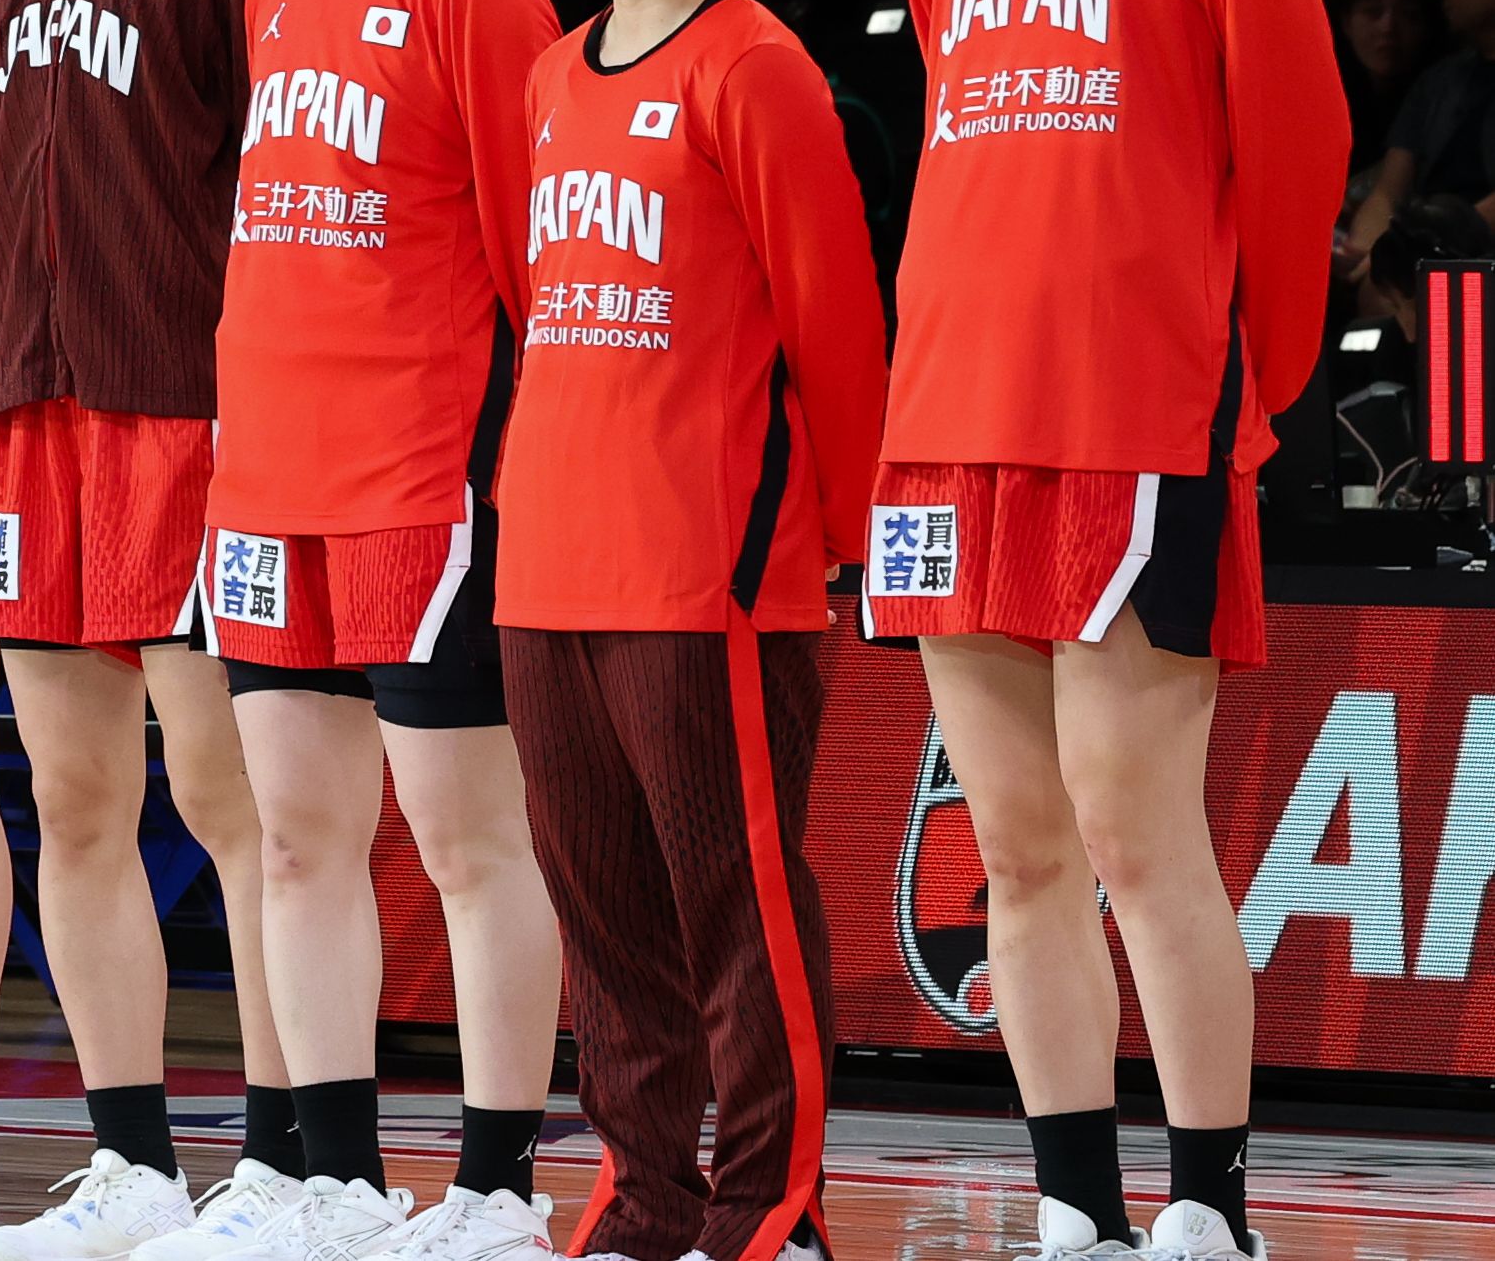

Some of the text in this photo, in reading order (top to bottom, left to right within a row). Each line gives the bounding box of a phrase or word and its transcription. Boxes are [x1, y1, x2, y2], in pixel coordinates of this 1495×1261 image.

[961, 66, 1121, 113] 三井不動産
[240, 68, 386, 165] JAPAN
[956, 111, 1116, 140] MITSUI FUDOSAN
[251, 180, 388, 226] 三井不動産
[298, 226, 385, 249] FUDOSAN
[534, 282, 674, 326] 三井不動産
[571, 327, 671, 351] FUDOSAN
[883, 511, 921, 591] 大吉
[919, 511, 954, 591] 買取
[222, 537, 254, 616] 大吉
[249, 542, 279, 621] 買取
